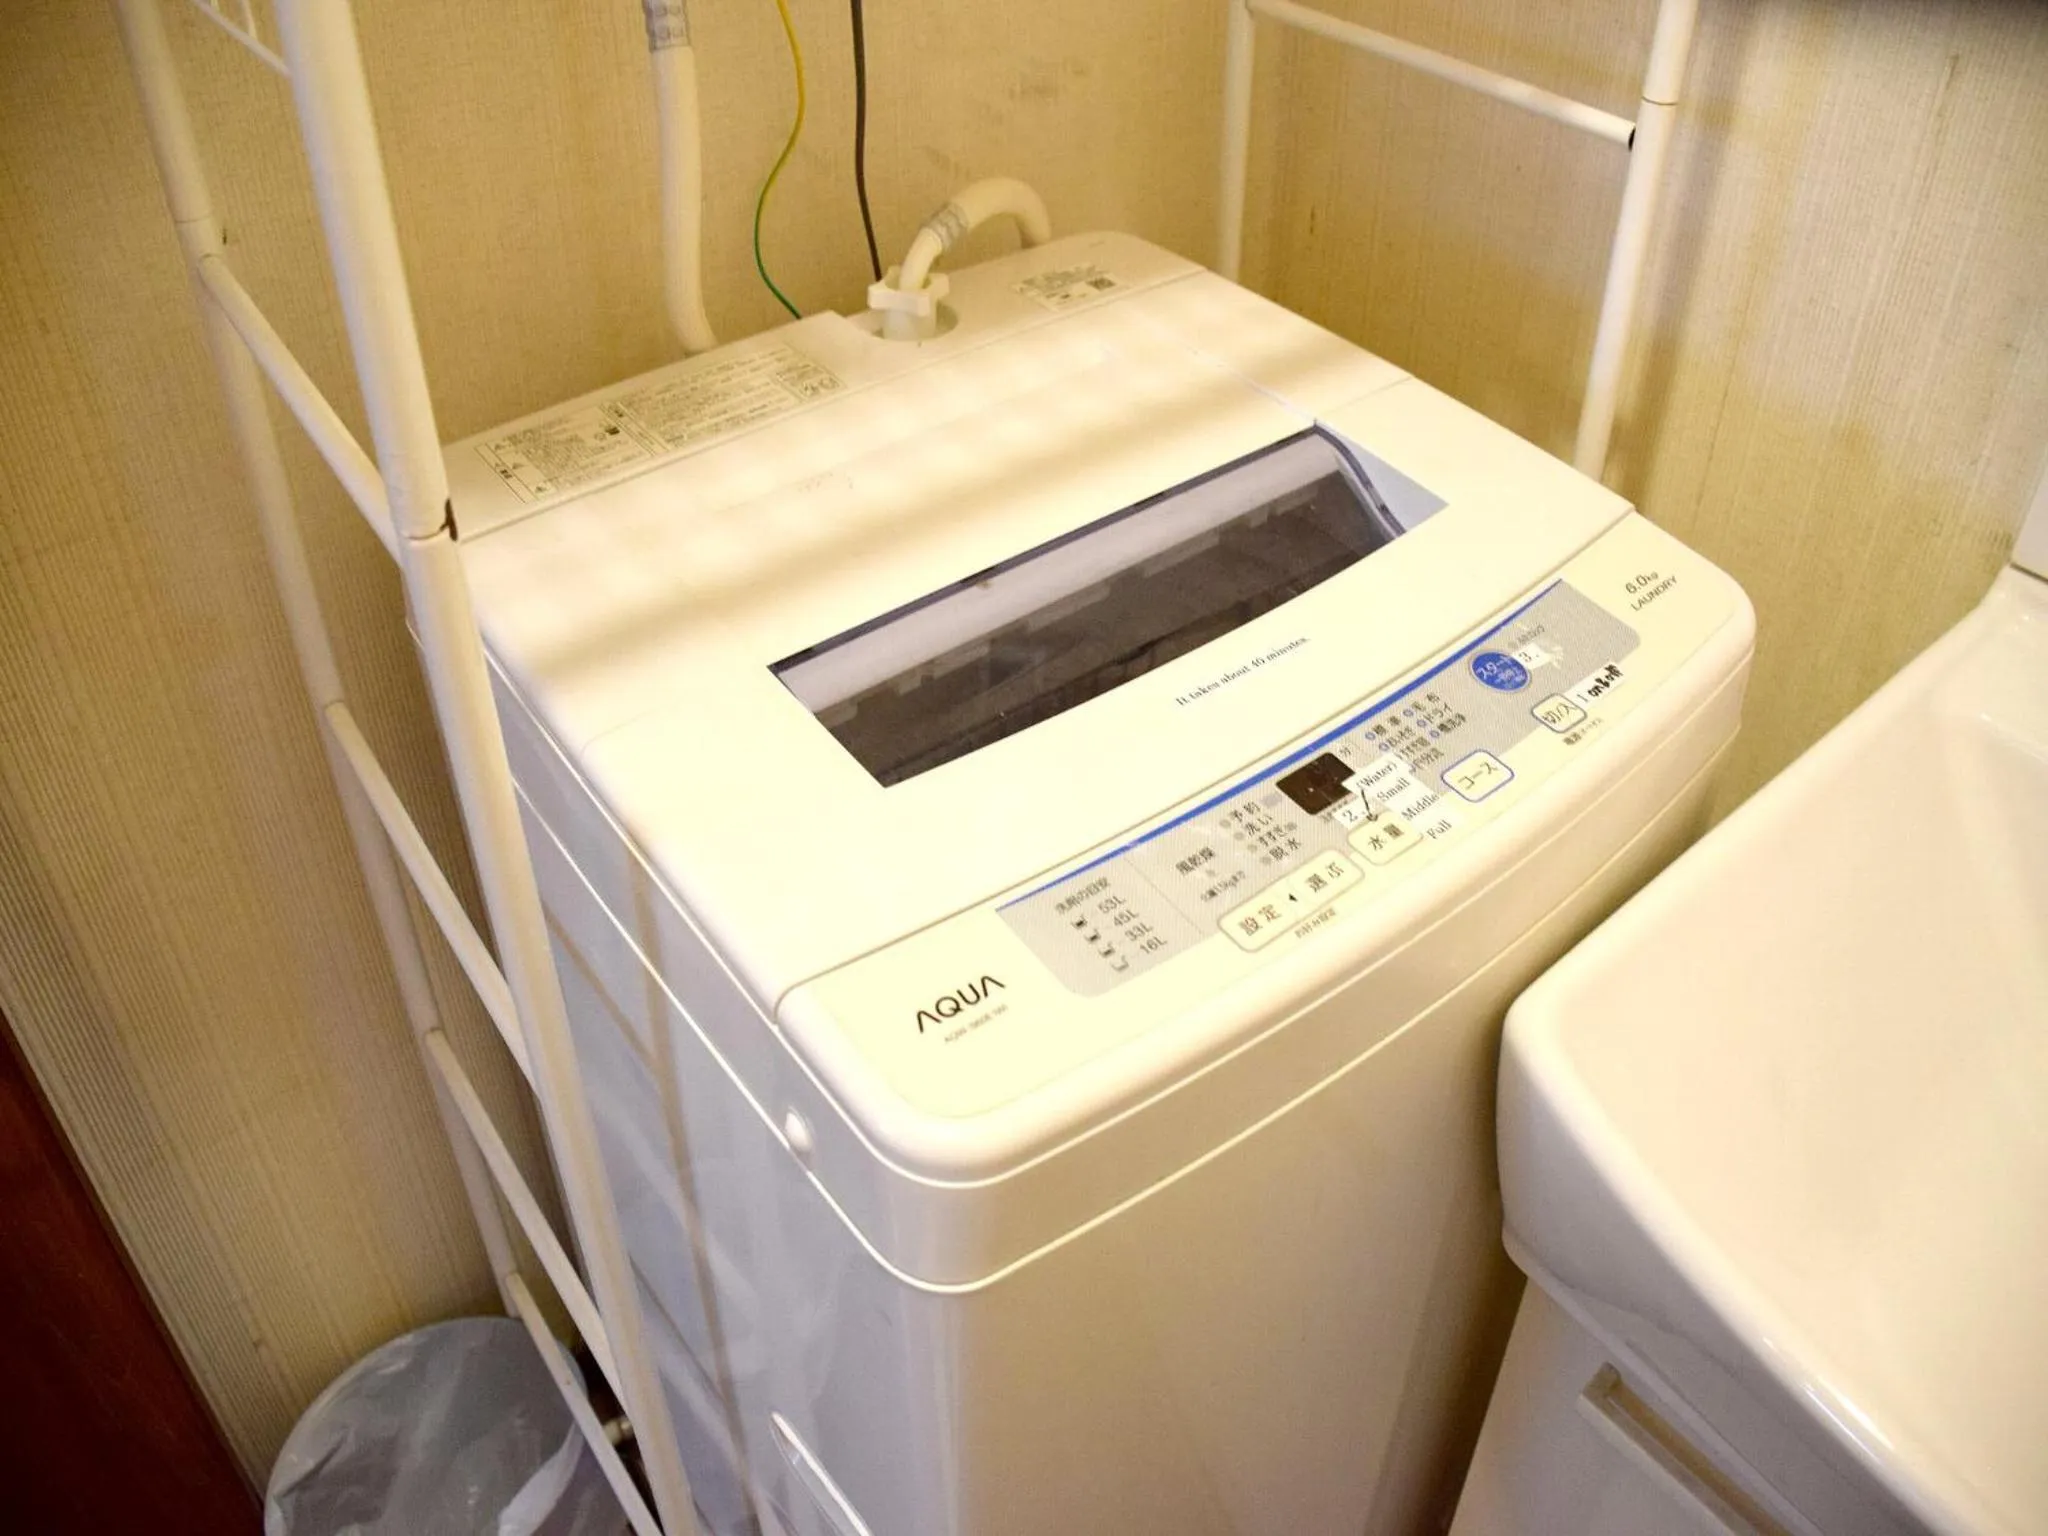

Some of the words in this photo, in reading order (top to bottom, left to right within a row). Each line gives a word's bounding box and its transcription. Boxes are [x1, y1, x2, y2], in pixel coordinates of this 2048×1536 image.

[1630, 574, 1677, 612] LAUNDRY
[1188, 681, 1221, 700] takes
[1220, 665, 1251, 685] about
[1376, 777, 1411, 803] Small
[1458, 761, 1499, 790] コース
[1400, 790, 1441, 822] Middle
[1098, 895, 1127, 914] 53L
[1238, 904, 1282, 936] 設定
[1305, 861, 1344, 893] 選ぶ
[1113, 909, 1139, 927] 45L
[1124, 922, 1154, 942] 33L
[1139, 936, 1168, 955] 16L
[916, 975, 1006, 1034] AQUA
